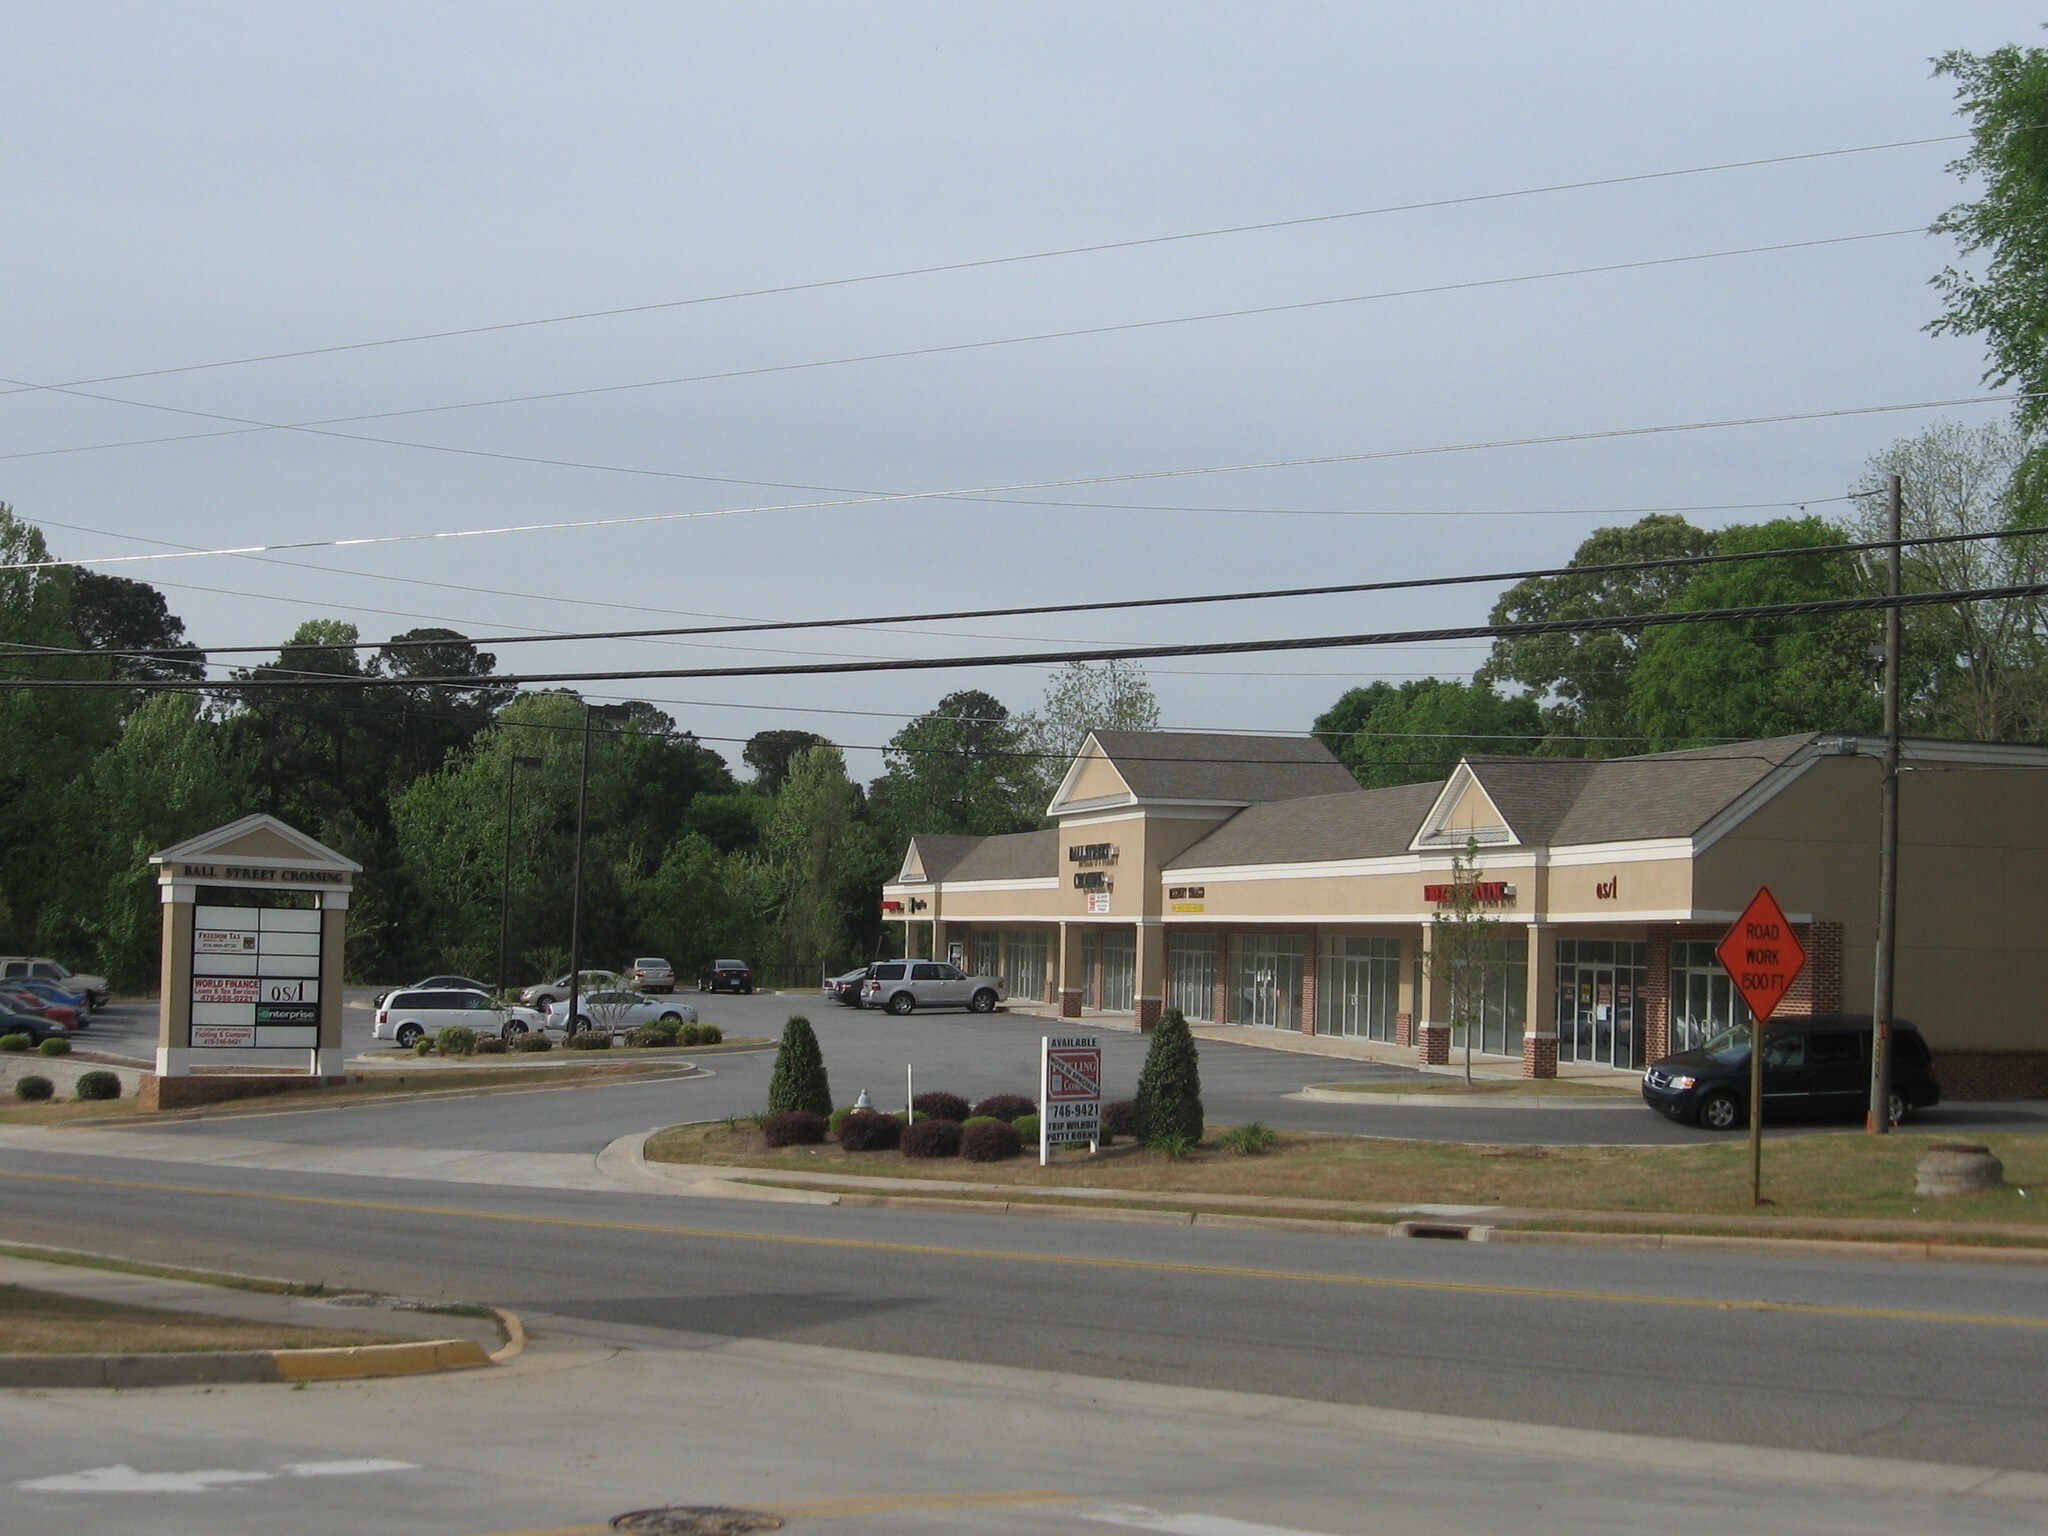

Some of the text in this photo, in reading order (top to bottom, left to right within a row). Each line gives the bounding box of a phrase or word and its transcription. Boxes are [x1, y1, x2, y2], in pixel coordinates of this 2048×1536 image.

[184, 865, 343, 883] BALL STREET CROSSING
[1746, 924, 1779, 940] ROAD
[1745, 948, 1779, 965] WORK
[195, 979, 259, 989] WORLD FINANCE
[1771, 974, 1785, 990] FT
[260, 1009, 315, 1020] enterprise
[1051, 1037, 1097, 1048] AVAILABLE
[1053, 1103, 1099, 1118] 746-9421
[1048, 1121, 1065, 1131] TRIP
[1047, 1132, 1070, 1141] PATTY
